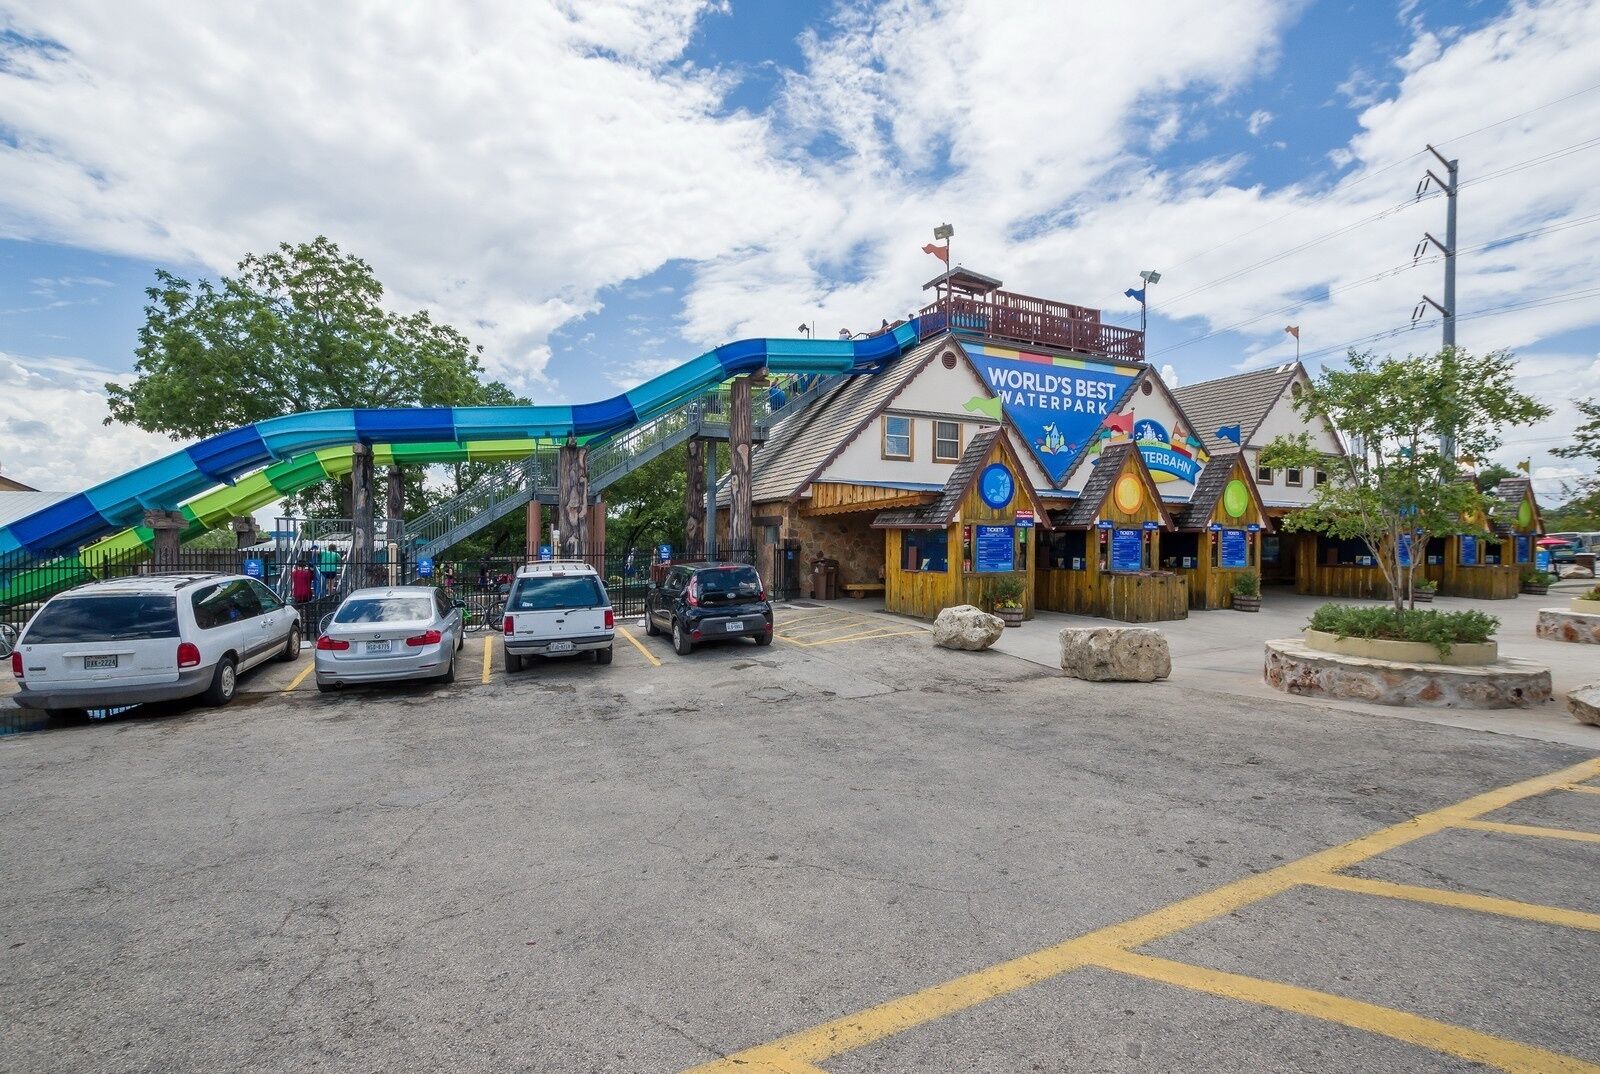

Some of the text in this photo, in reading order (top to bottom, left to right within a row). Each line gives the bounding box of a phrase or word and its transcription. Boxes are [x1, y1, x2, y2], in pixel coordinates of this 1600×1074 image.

[988, 367, 1117, 401] WORLD'S BEST
[997, 389, 1107, 415] WATERPARK
